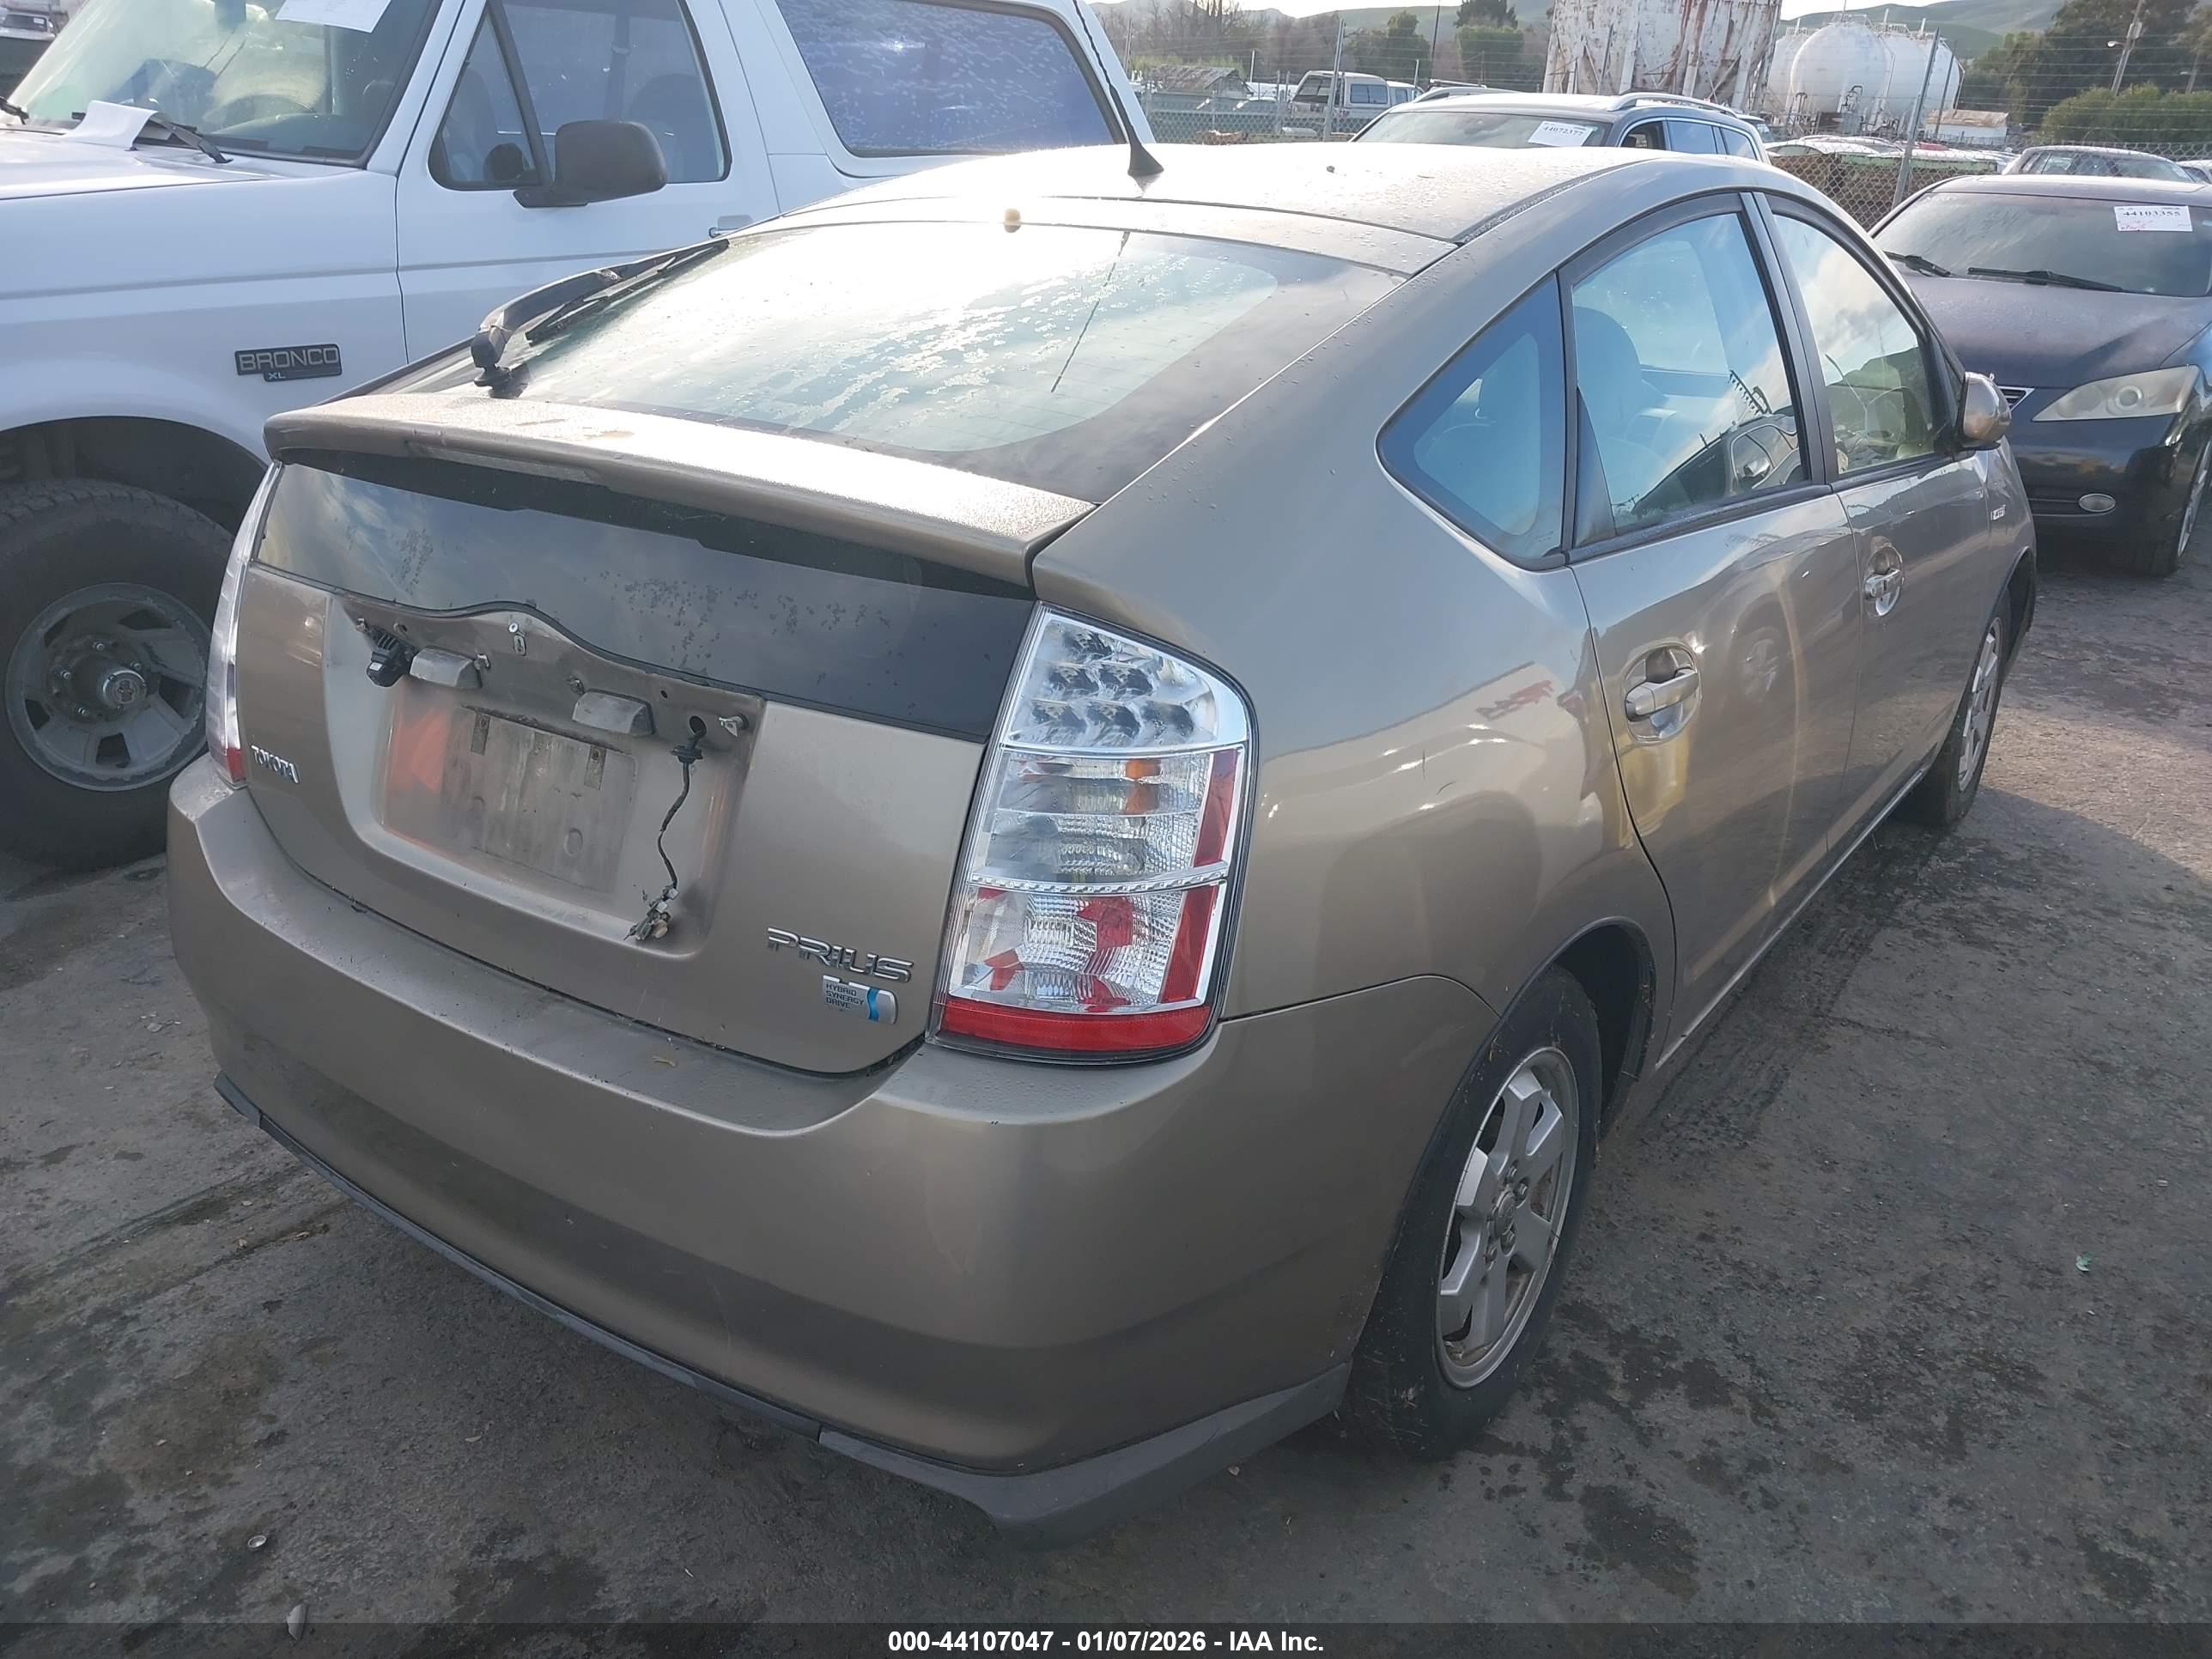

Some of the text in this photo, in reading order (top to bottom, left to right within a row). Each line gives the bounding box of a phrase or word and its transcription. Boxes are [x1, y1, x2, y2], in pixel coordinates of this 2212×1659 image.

[239, 348, 339, 371] BRONCO
[252, 745, 298, 783] TOYOTA
[768, 927, 914, 981] PRIUS
[826, 983, 857, 997] HYBRID
[826, 990, 865, 1006] SYNERGY
[826, 997, 851, 1009] DRIVE
